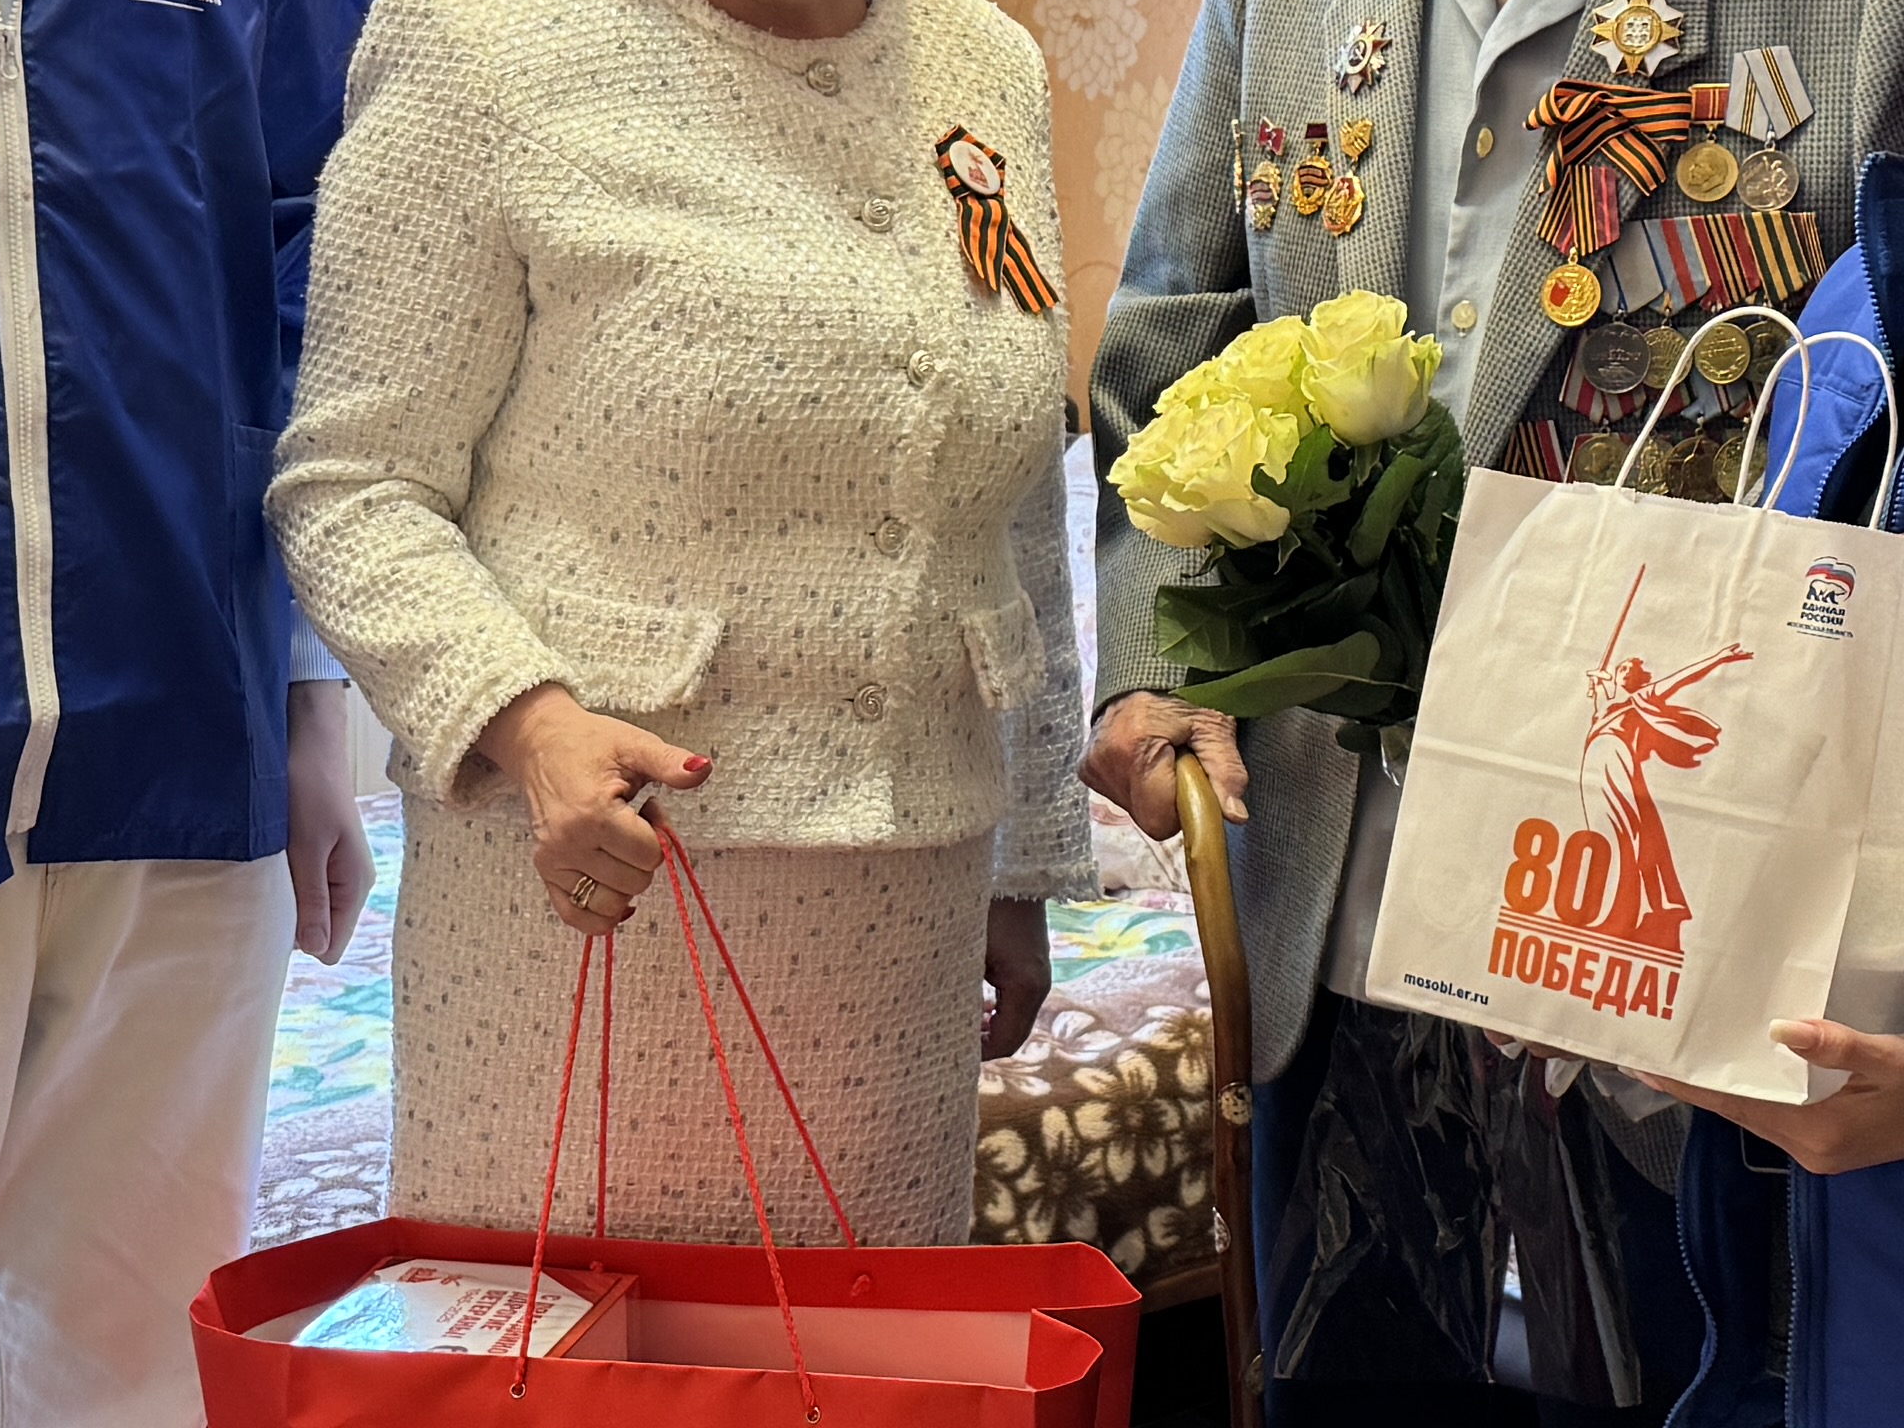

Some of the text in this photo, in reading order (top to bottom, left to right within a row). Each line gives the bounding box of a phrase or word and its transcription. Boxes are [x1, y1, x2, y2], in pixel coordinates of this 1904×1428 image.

[1503, 817, 1612, 928] 80
[1403, 971, 1489, 1007] mosobl.er.ru
[1488, 926, 1681, 1020] ПОБЕДА!
